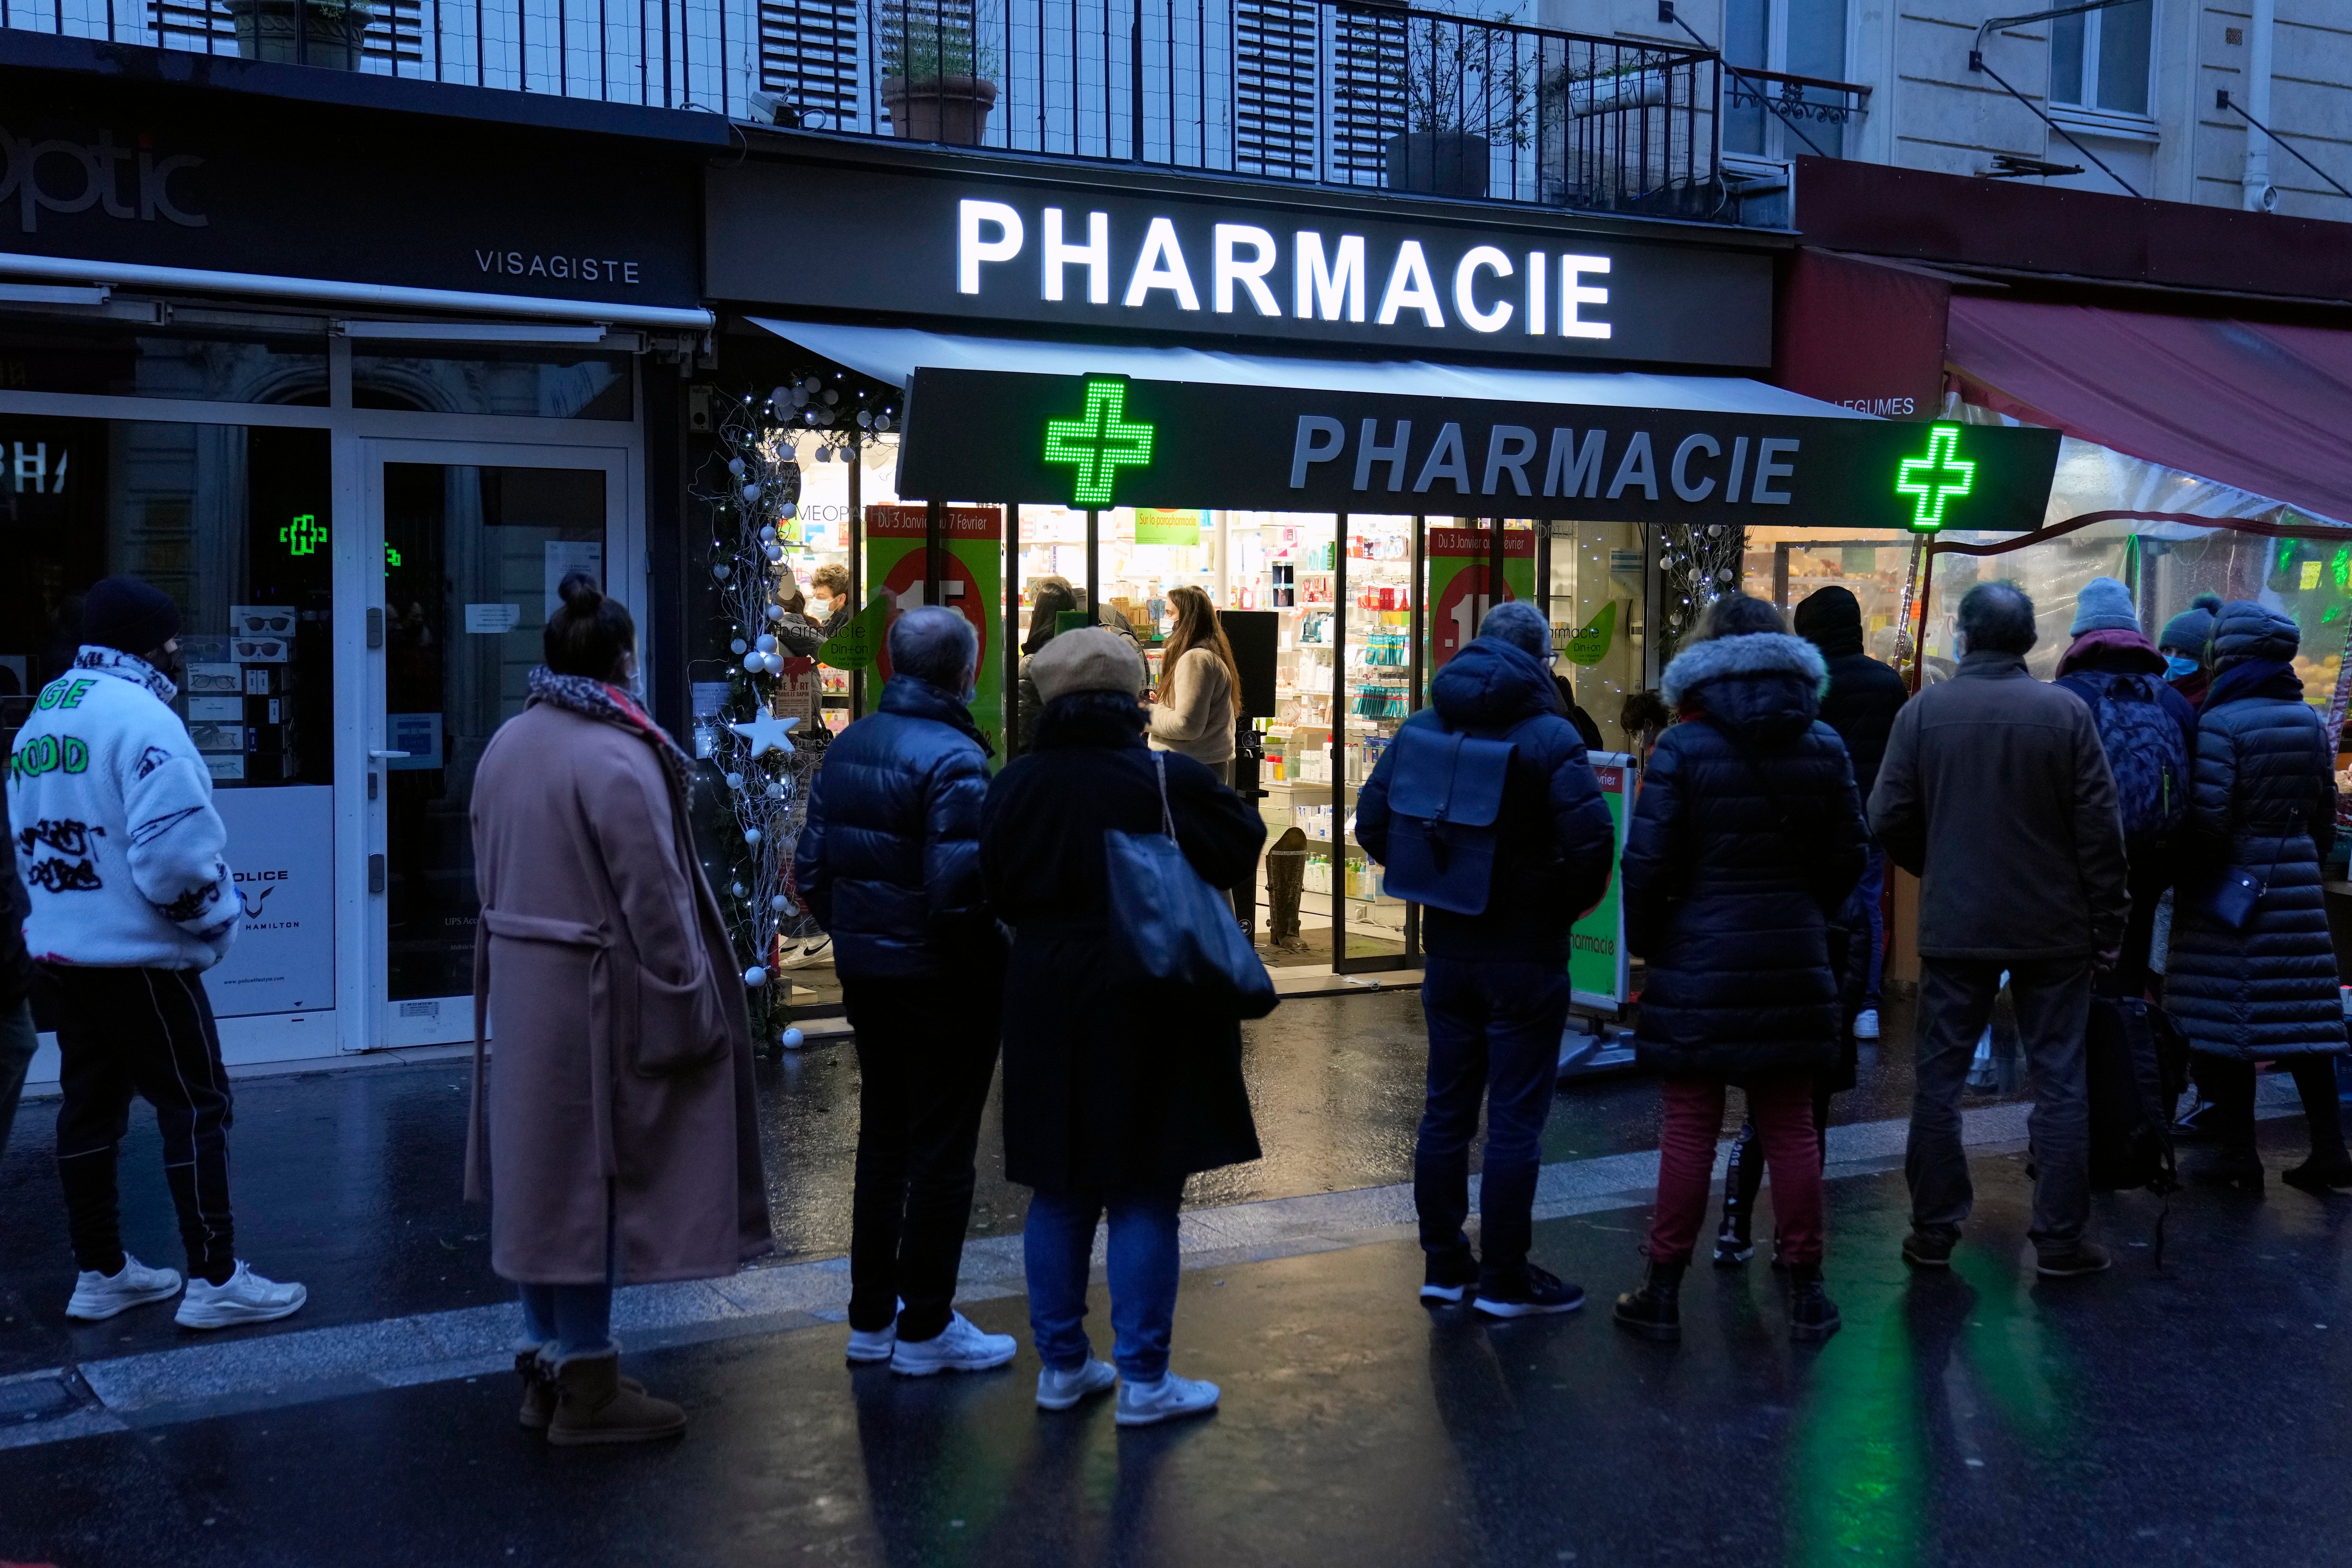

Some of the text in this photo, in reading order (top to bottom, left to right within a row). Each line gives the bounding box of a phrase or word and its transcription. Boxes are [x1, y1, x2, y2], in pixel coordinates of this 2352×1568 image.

[0, 125, 209, 232] ptic
[475, 250, 639, 283] VISAGISTE
[958, 200, 1611, 339] PHARMACIE
[1290, 414, 1800, 505] PHARMACIE
[878, 512, 890, 528] Du
[893, 512, 900, 528] 3
[949, 514, 955, 529] 7
[957, 514, 987, 530] Février
[1140, 514, 1196, 528] Sur la parapharmacie
[1438, 534, 1448, 548] Du
[1450, 534, 1455, 548] 3
[1456, 534, 1481, 548] Janvier
[1504, 536, 1524, 550] évrier
[33, 679, 100, 713] GE
[246, 921, 299, 930] HAMILTON
[445, 917, 461, 926] UPS
[224, 976, 285, 985] www.policelifestyle.com
